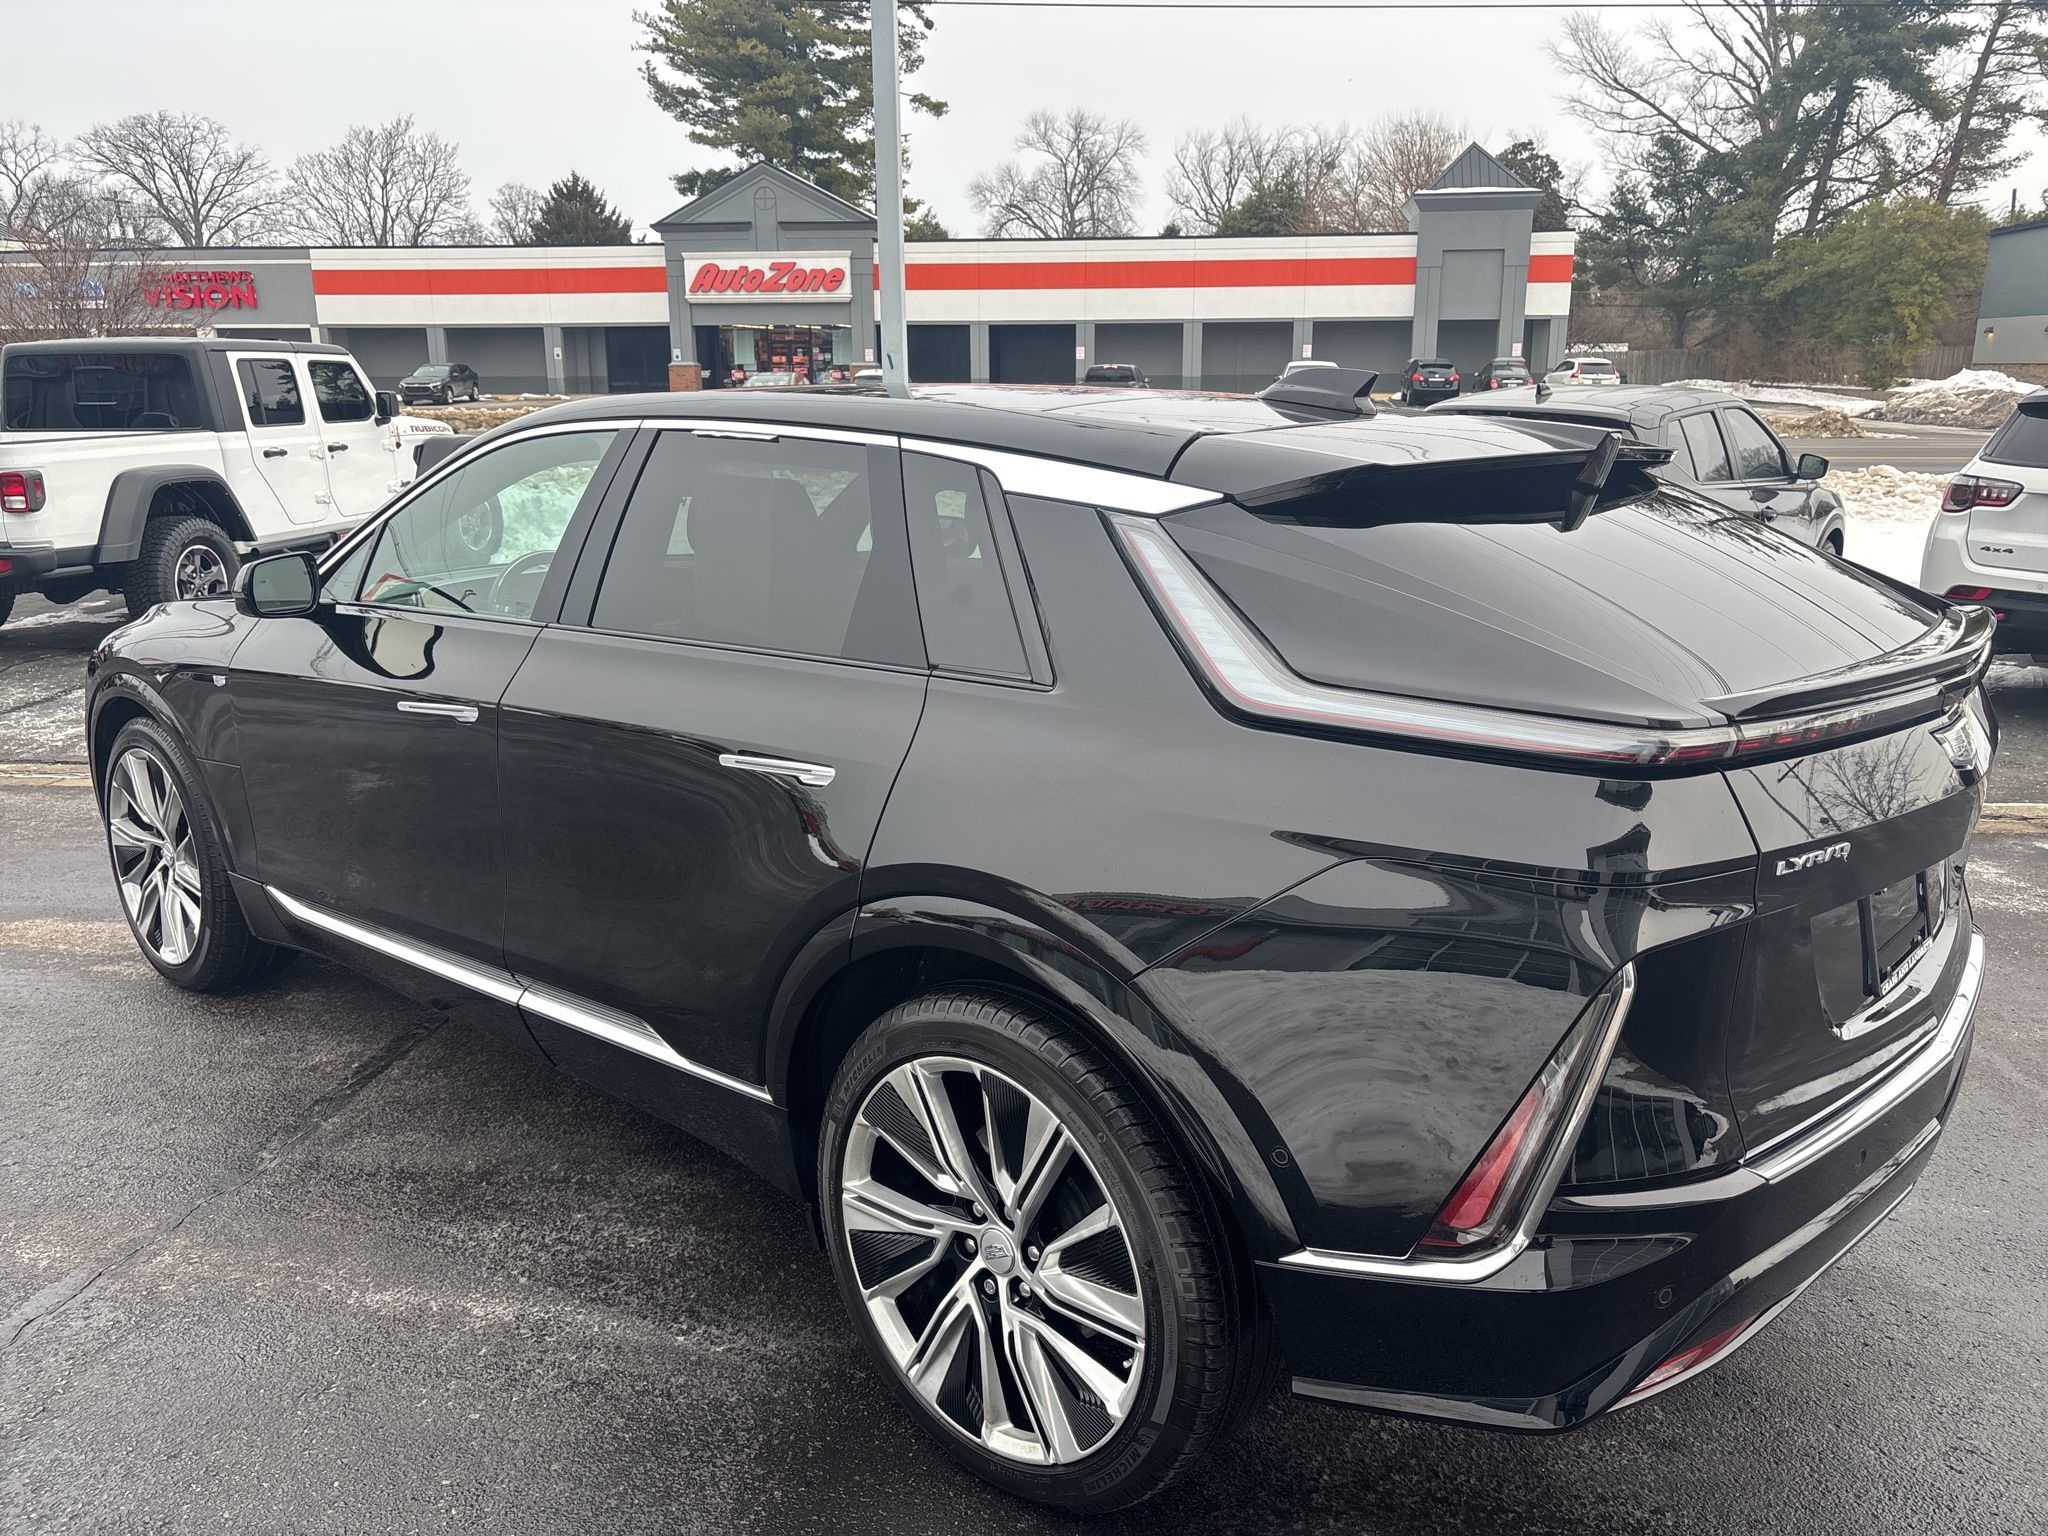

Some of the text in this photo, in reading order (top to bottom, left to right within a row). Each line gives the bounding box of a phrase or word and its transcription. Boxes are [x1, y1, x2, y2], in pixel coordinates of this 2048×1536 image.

[690, 262, 846, 293] AutoZone
[143, 284, 258, 309] VISION
[410, 425, 451, 433] RUBICON
[1776, 842, 1851, 876] LYRIQ
